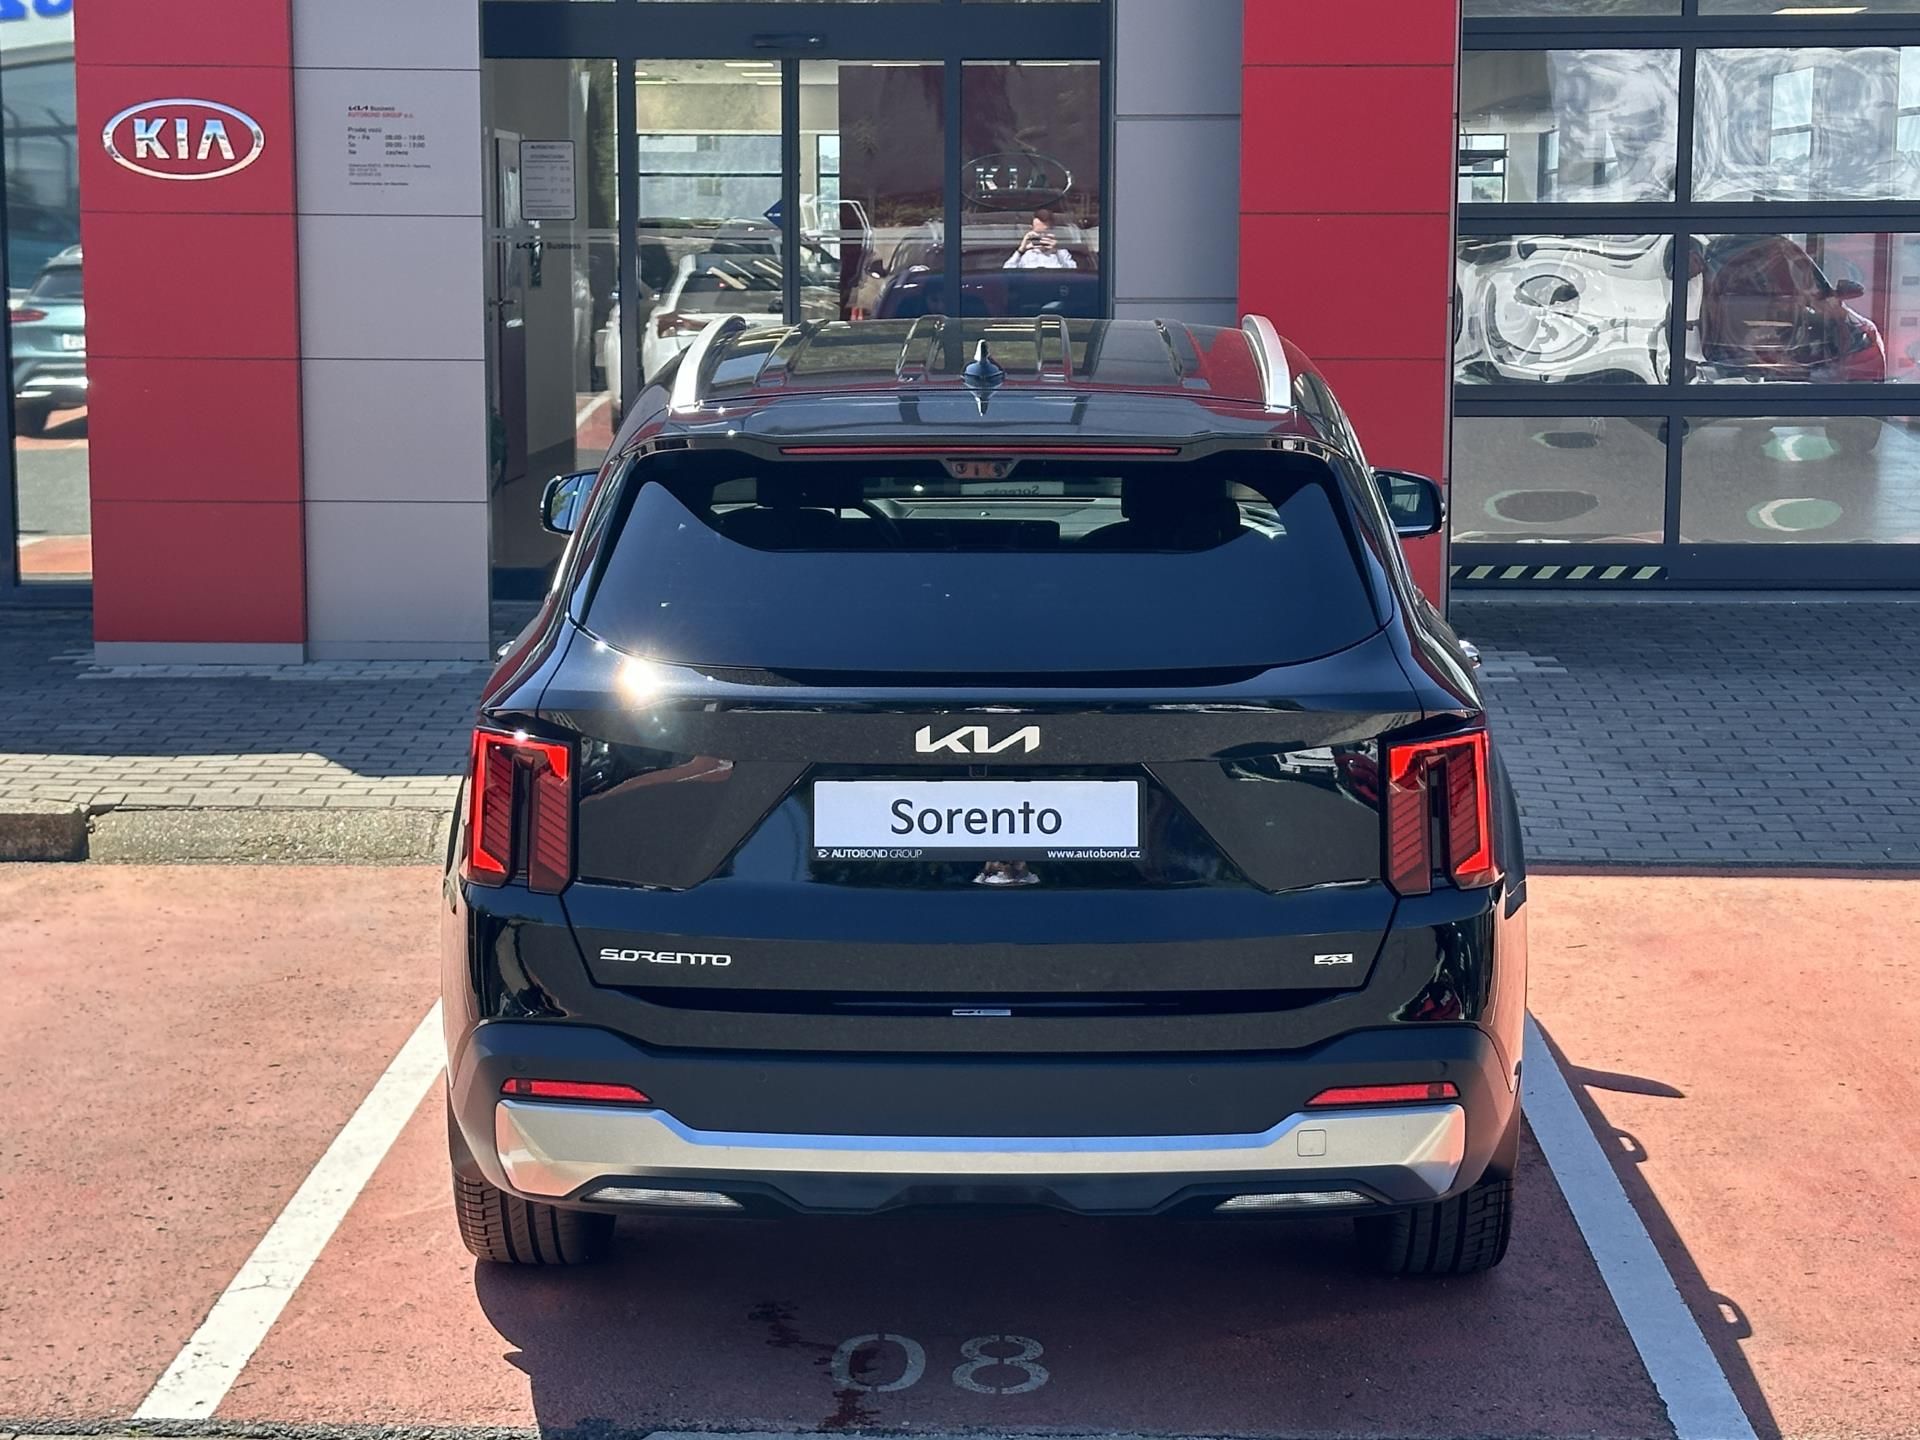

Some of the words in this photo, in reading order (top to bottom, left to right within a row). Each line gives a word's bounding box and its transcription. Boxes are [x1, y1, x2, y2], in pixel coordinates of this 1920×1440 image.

[133, 118, 235, 160] KIA
[915, 725, 1041, 753] KIA
[890, 798, 1062, 834] Sorento
[831, 849, 888, 858] AUTOBOND
[889, 849, 923, 858] GROUP
[1047, 848, 1141, 858] www.autobond.cz
[600, 948, 732, 966] SORENTO
[831, 1333, 1049, 1394] 08
